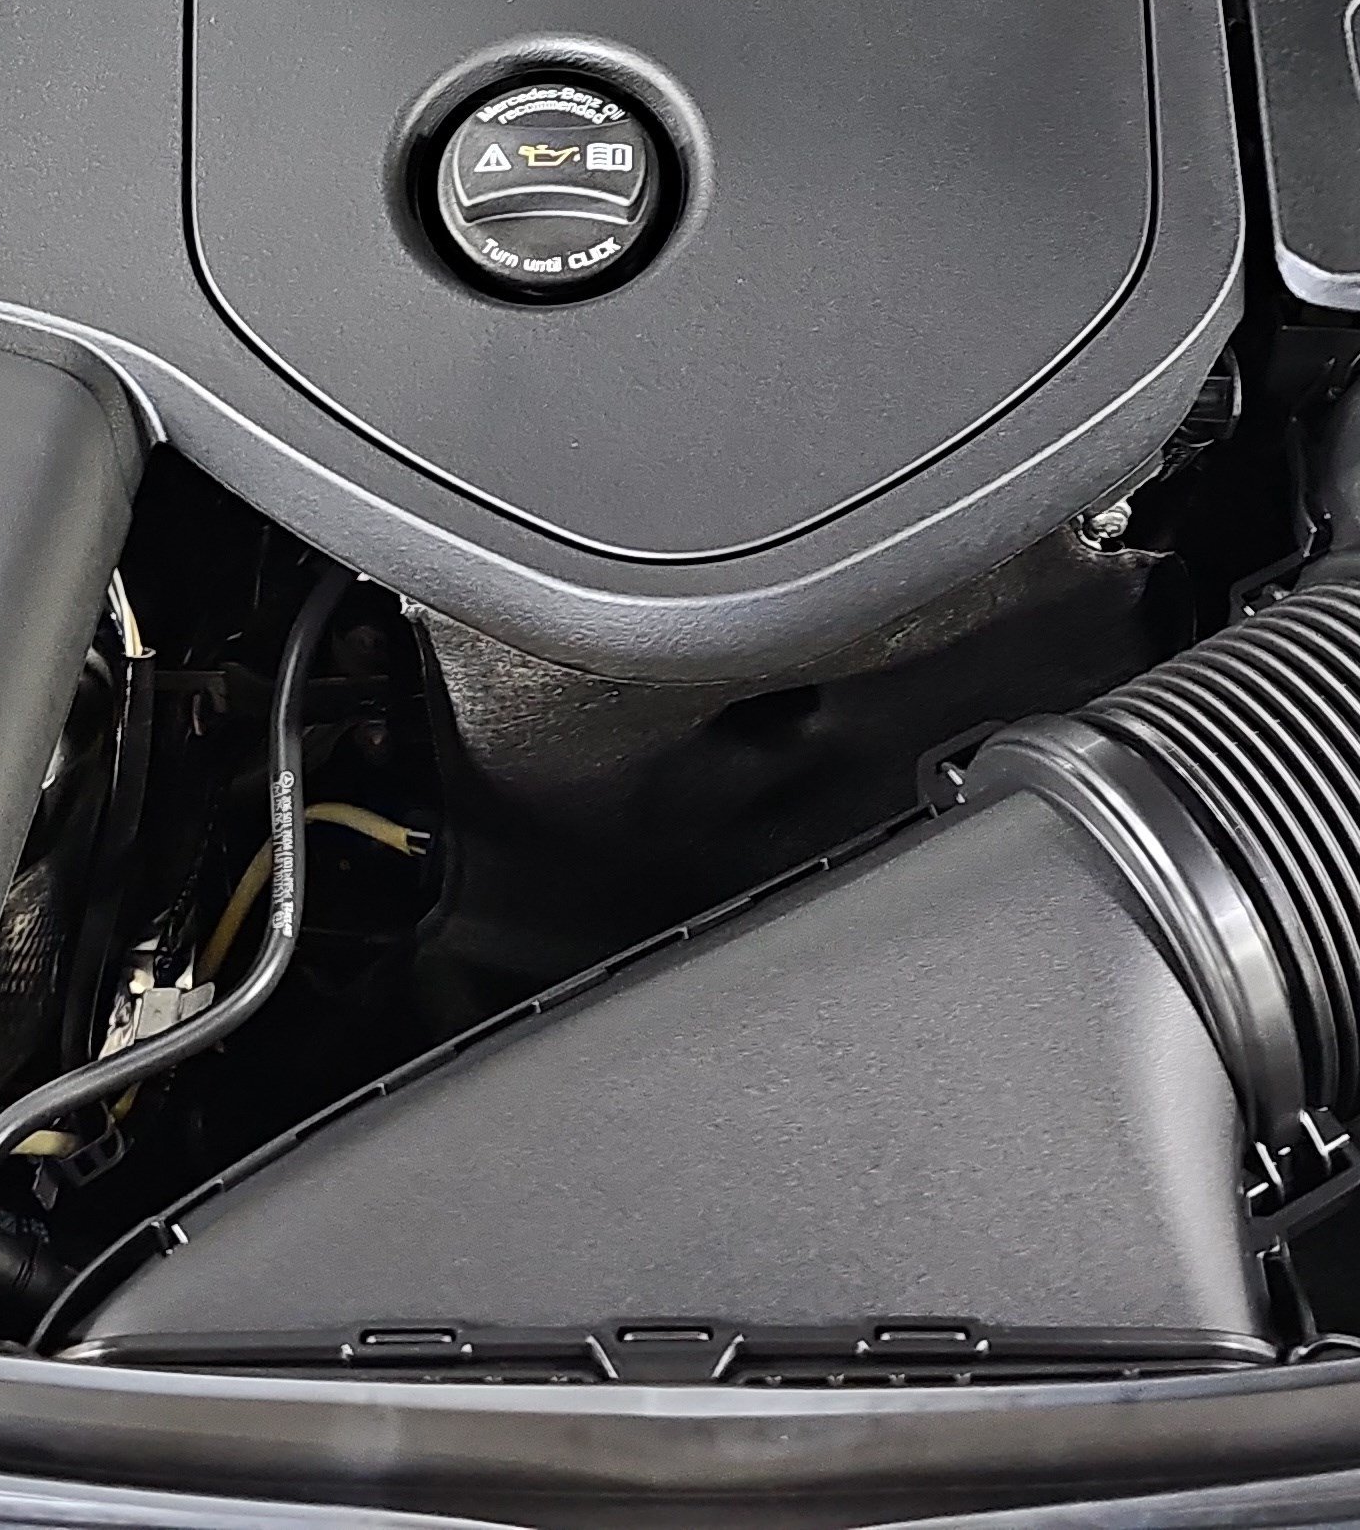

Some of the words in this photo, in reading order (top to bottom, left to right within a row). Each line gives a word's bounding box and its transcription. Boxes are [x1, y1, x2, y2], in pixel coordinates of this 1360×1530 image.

[477, 87, 605, 122] Mercedes-Benz
[604, 100, 628, 122] Oil
[499, 98, 606, 124] recommended
[480, 238, 520, 269] Turn
[523, 256, 563, 273] until
[567, 236, 623, 270] CLICK
